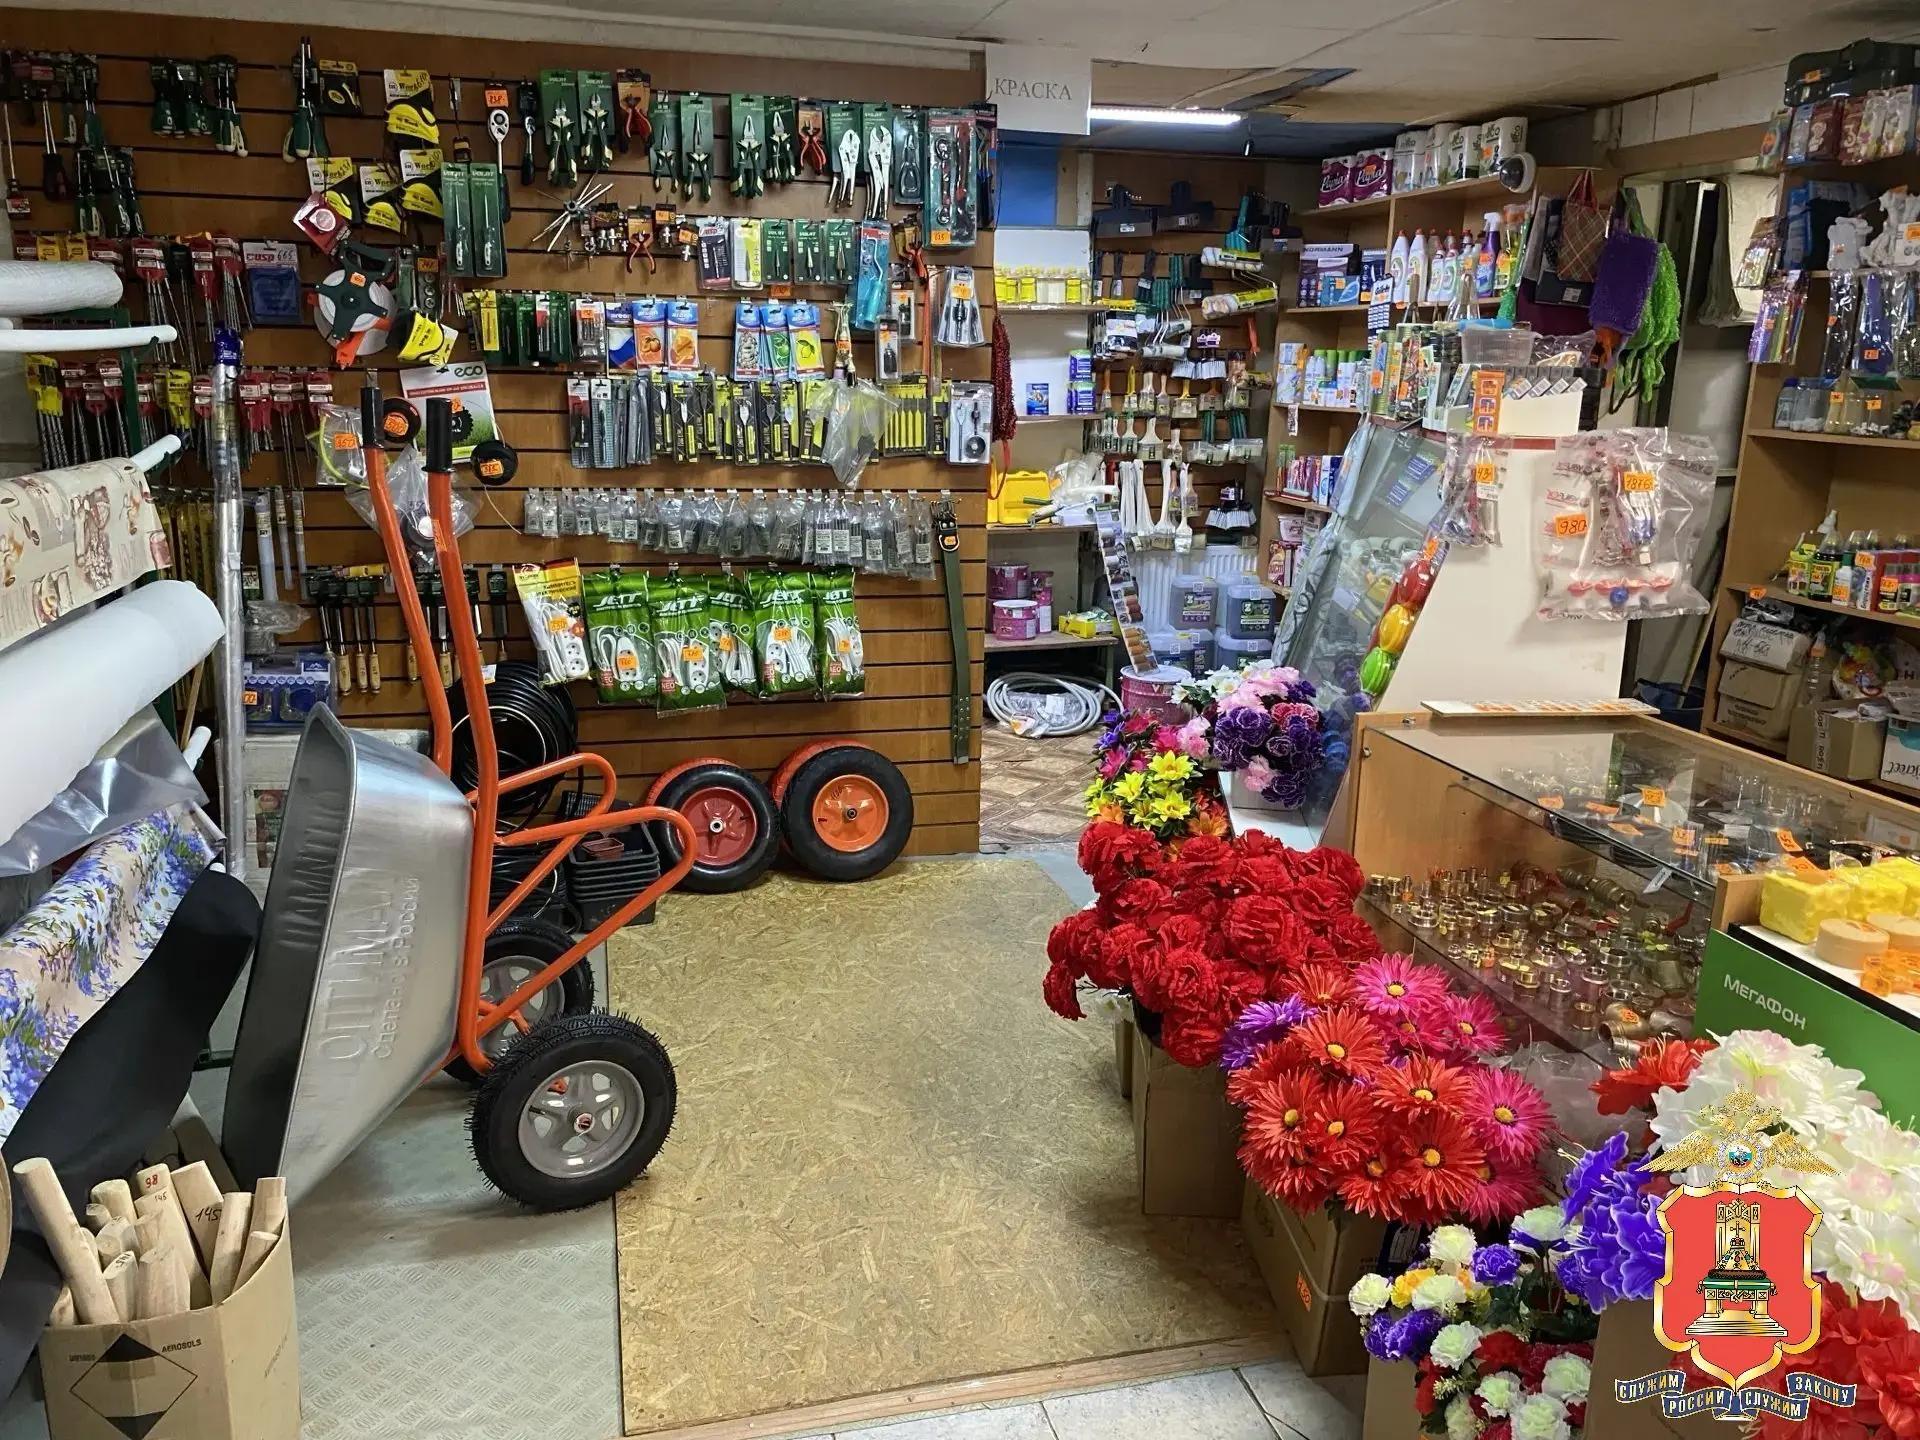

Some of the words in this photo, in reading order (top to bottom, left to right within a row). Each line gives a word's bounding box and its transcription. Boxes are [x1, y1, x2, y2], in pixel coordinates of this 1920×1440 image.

[994, 77, 1073, 101] КРАСКА
[454, 365, 484, 378] eco
[1723, 973, 1806, 1030] МЕГАФОН
[145, 1174, 158, 1188] 98
[195, 1208, 222, 1222] 145
[161, 1338, 202, 1354] AEROSOLS
